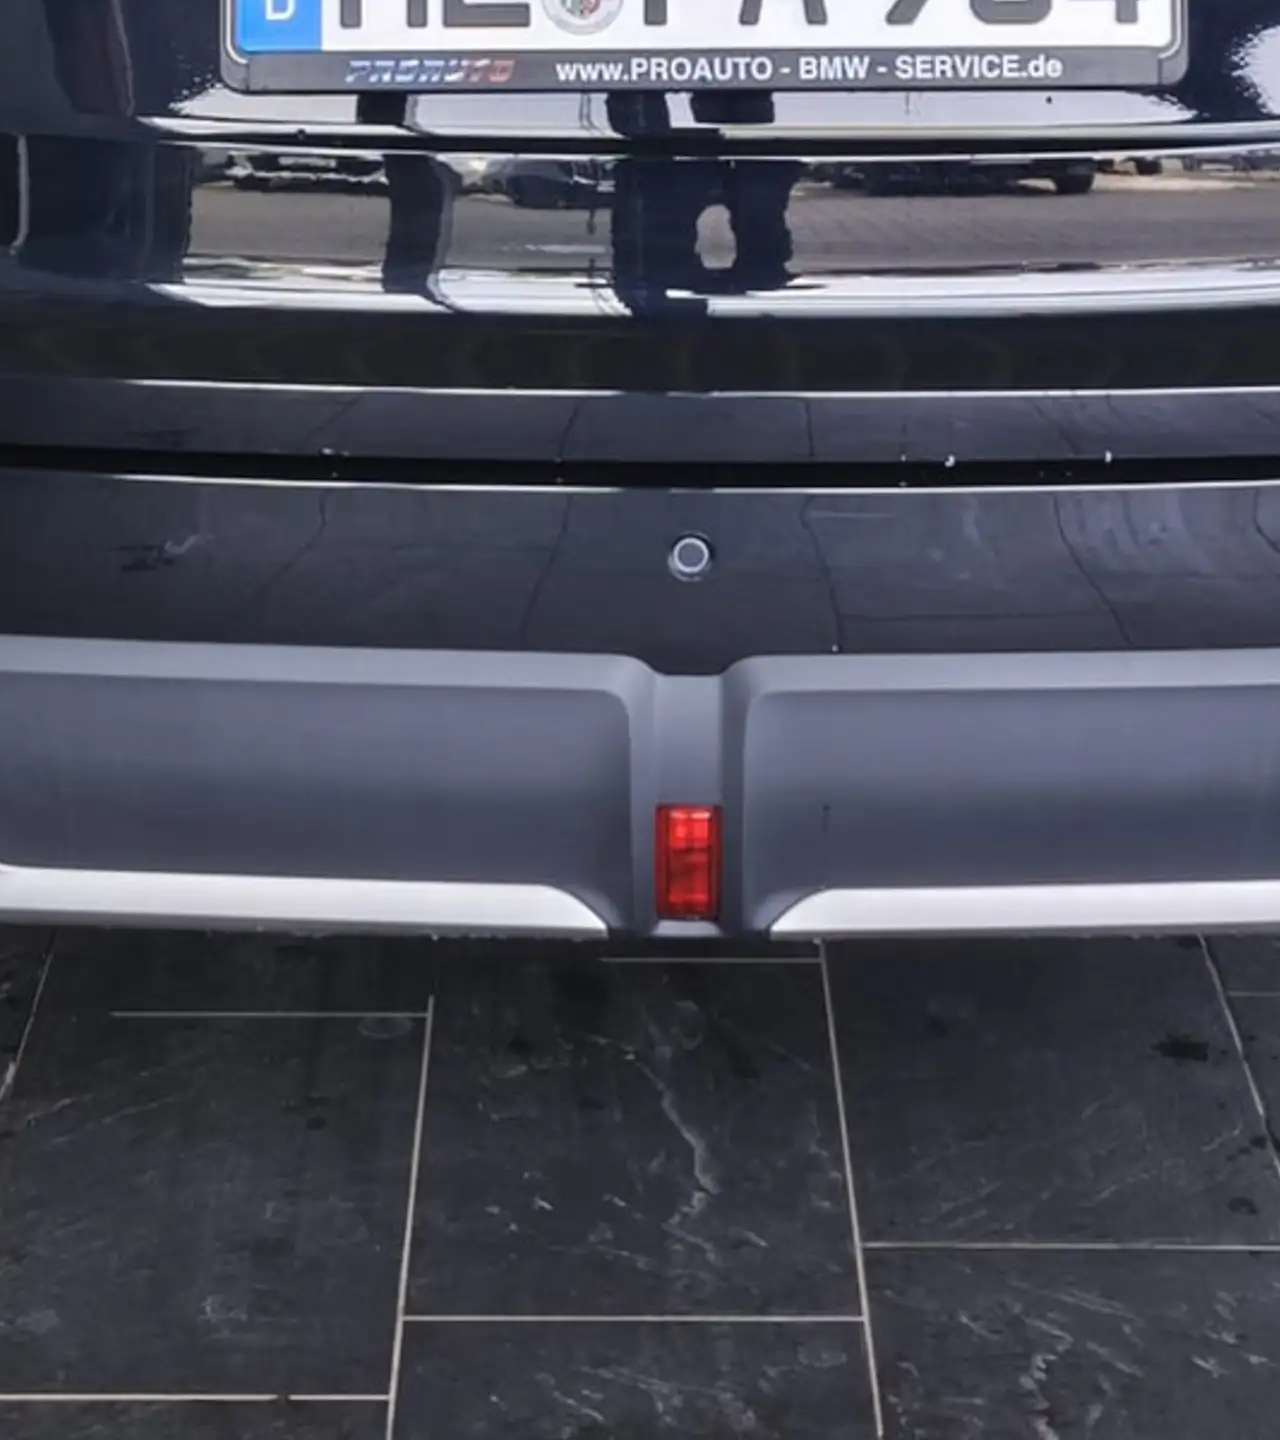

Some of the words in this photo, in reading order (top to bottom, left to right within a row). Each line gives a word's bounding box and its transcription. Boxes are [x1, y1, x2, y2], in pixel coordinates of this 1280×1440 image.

[555, 57, 772, 82] www.PROAUTO
[799, 56, 871, 80] BMW
[894, 54, 1064, 79] SERVICE.de
